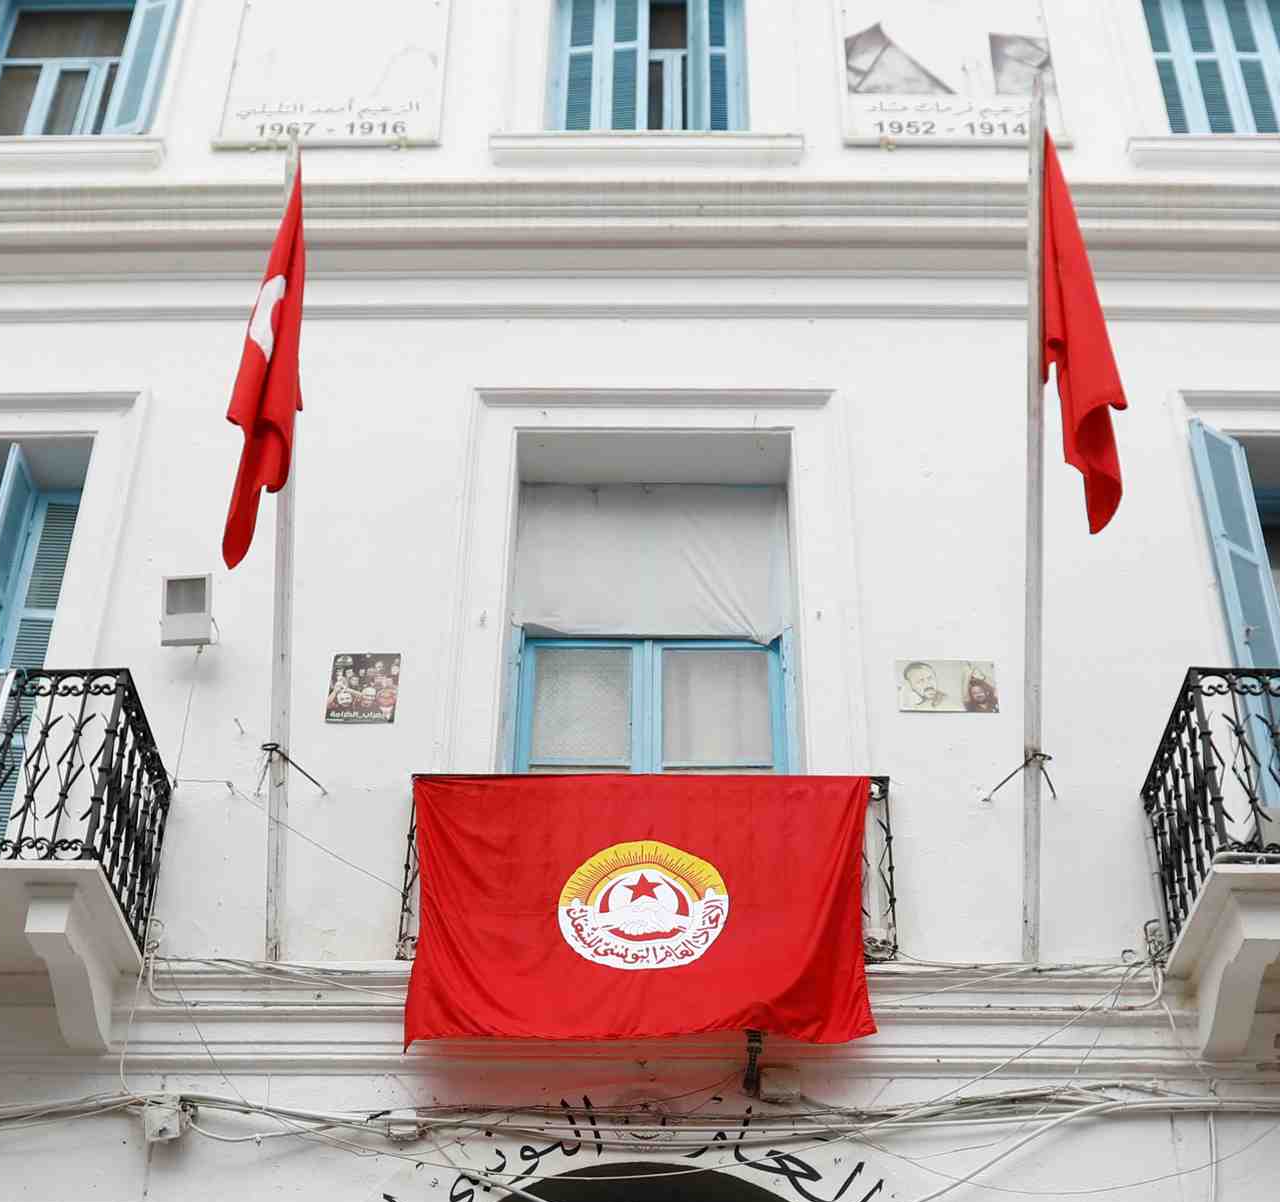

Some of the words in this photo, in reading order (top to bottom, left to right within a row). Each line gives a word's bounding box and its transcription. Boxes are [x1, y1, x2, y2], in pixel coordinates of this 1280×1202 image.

[256, 121, 316, 137] 1967
[346, 120, 408, 136] 1916
[873, 120, 937, 136] 1952
[964, 121, 1028, 136] 1914
